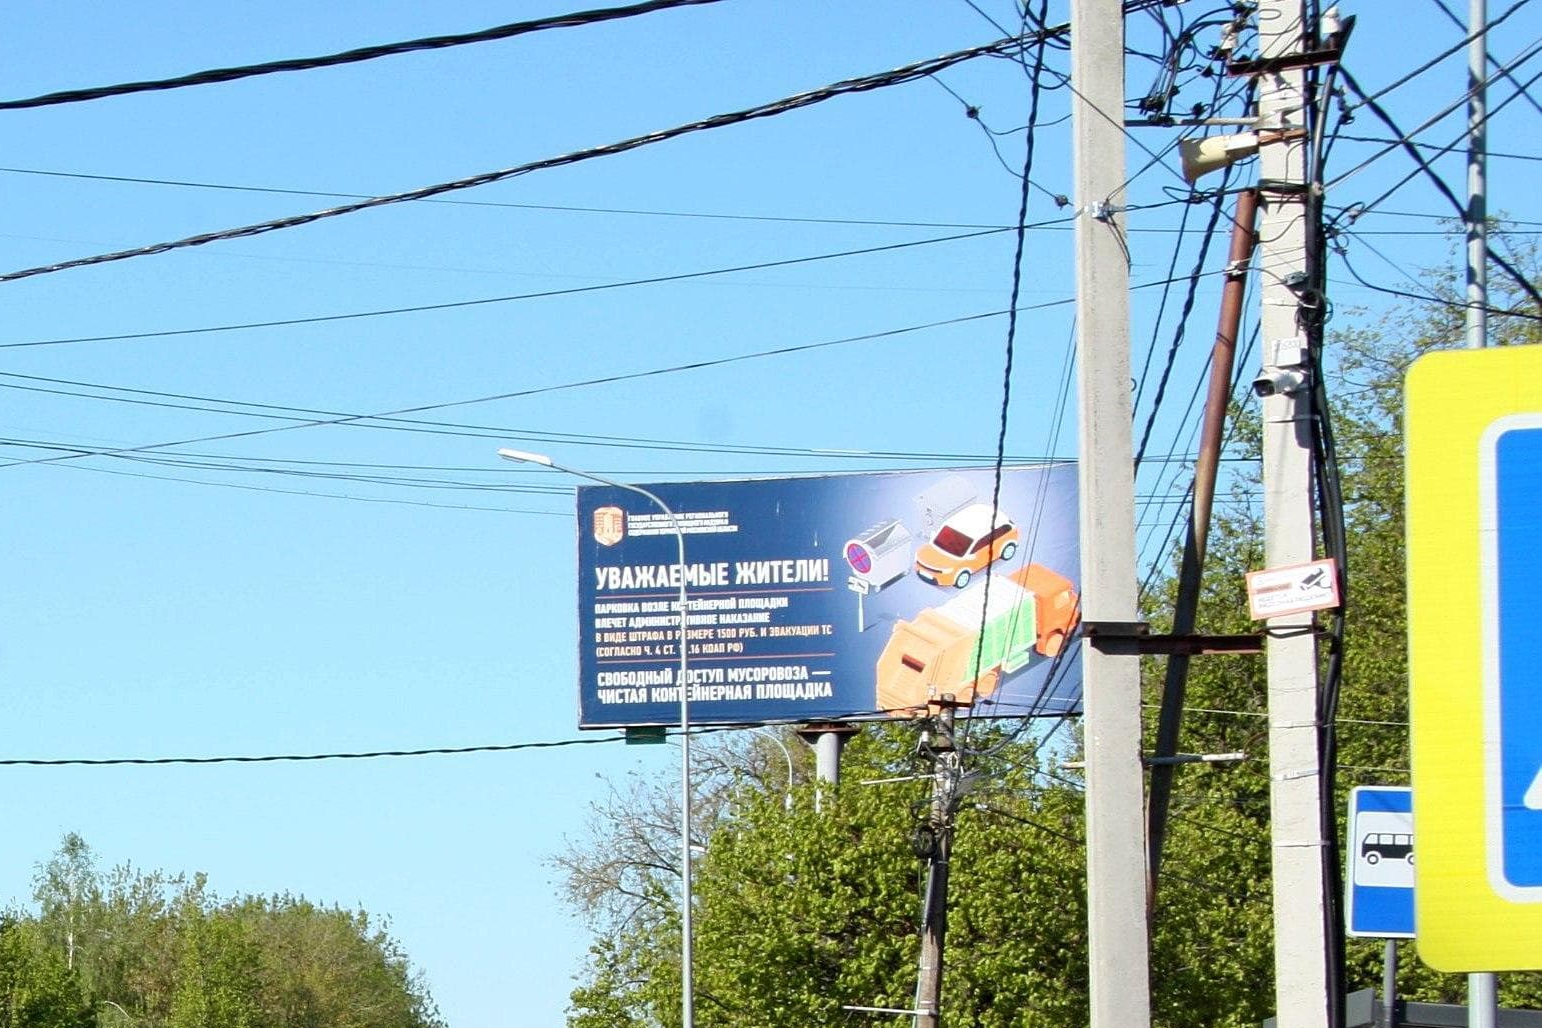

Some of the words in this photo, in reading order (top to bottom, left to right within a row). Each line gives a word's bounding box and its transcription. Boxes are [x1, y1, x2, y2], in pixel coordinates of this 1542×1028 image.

[595, 563, 729, 590] УВАЖАЕМЫЕ
[735, 559, 829, 585] ЖИТЕЛИ!
[595, 602, 639, 614] ПАРКОВКА
[641, 601, 669, 612] ВОЗЛЕ
[671, 597, 736, 611] КОТЕЙНЕРНОЙ
[595, 617, 627, 628] ВЛЕЧЕТ
[628, 614, 718, 628] АДМИНИСТРТИВНОЕ
[719, 612, 770, 624] НАКАЗАНИЕ
[595, 633, 601, 642] В
[603, 632, 626, 643] ВИДЕ
[629, 630, 664, 641] ШТРАФА
[666, 630, 673, 640] В
[675, 628, 714, 640] РЗМЕРЕ
[717, 628, 736, 638] 1500
[738, 627, 758, 638] РУБ.
[760, 626, 767, 637] И
[769, 625, 819, 637] ЭВАКУАЦИИ
[821, 624, 832, 634] ТС
[596, 645, 642, 657] (СОГЛАСНО
[644, 646, 653, 656] Ч.
[655, 645, 661, 655] 4
[663, 645, 676, 655] СТ.
[702, 643, 725, 654] КОАП
[727, 642, 744, 653] РФ)
[597, 667, 673, 687] СВОБОДНЫЙ
[676, 668, 724, 686] ДОСТУП
[727, 665, 809, 683] МУСОРОВОЗА
[597, 687, 648, 704] ЧИСТАЯ
[651, 683, 753, 703] КОНТЕЙНЕРНАЯ
[756, 681, 833, 701] ПЛОЩАДКА
